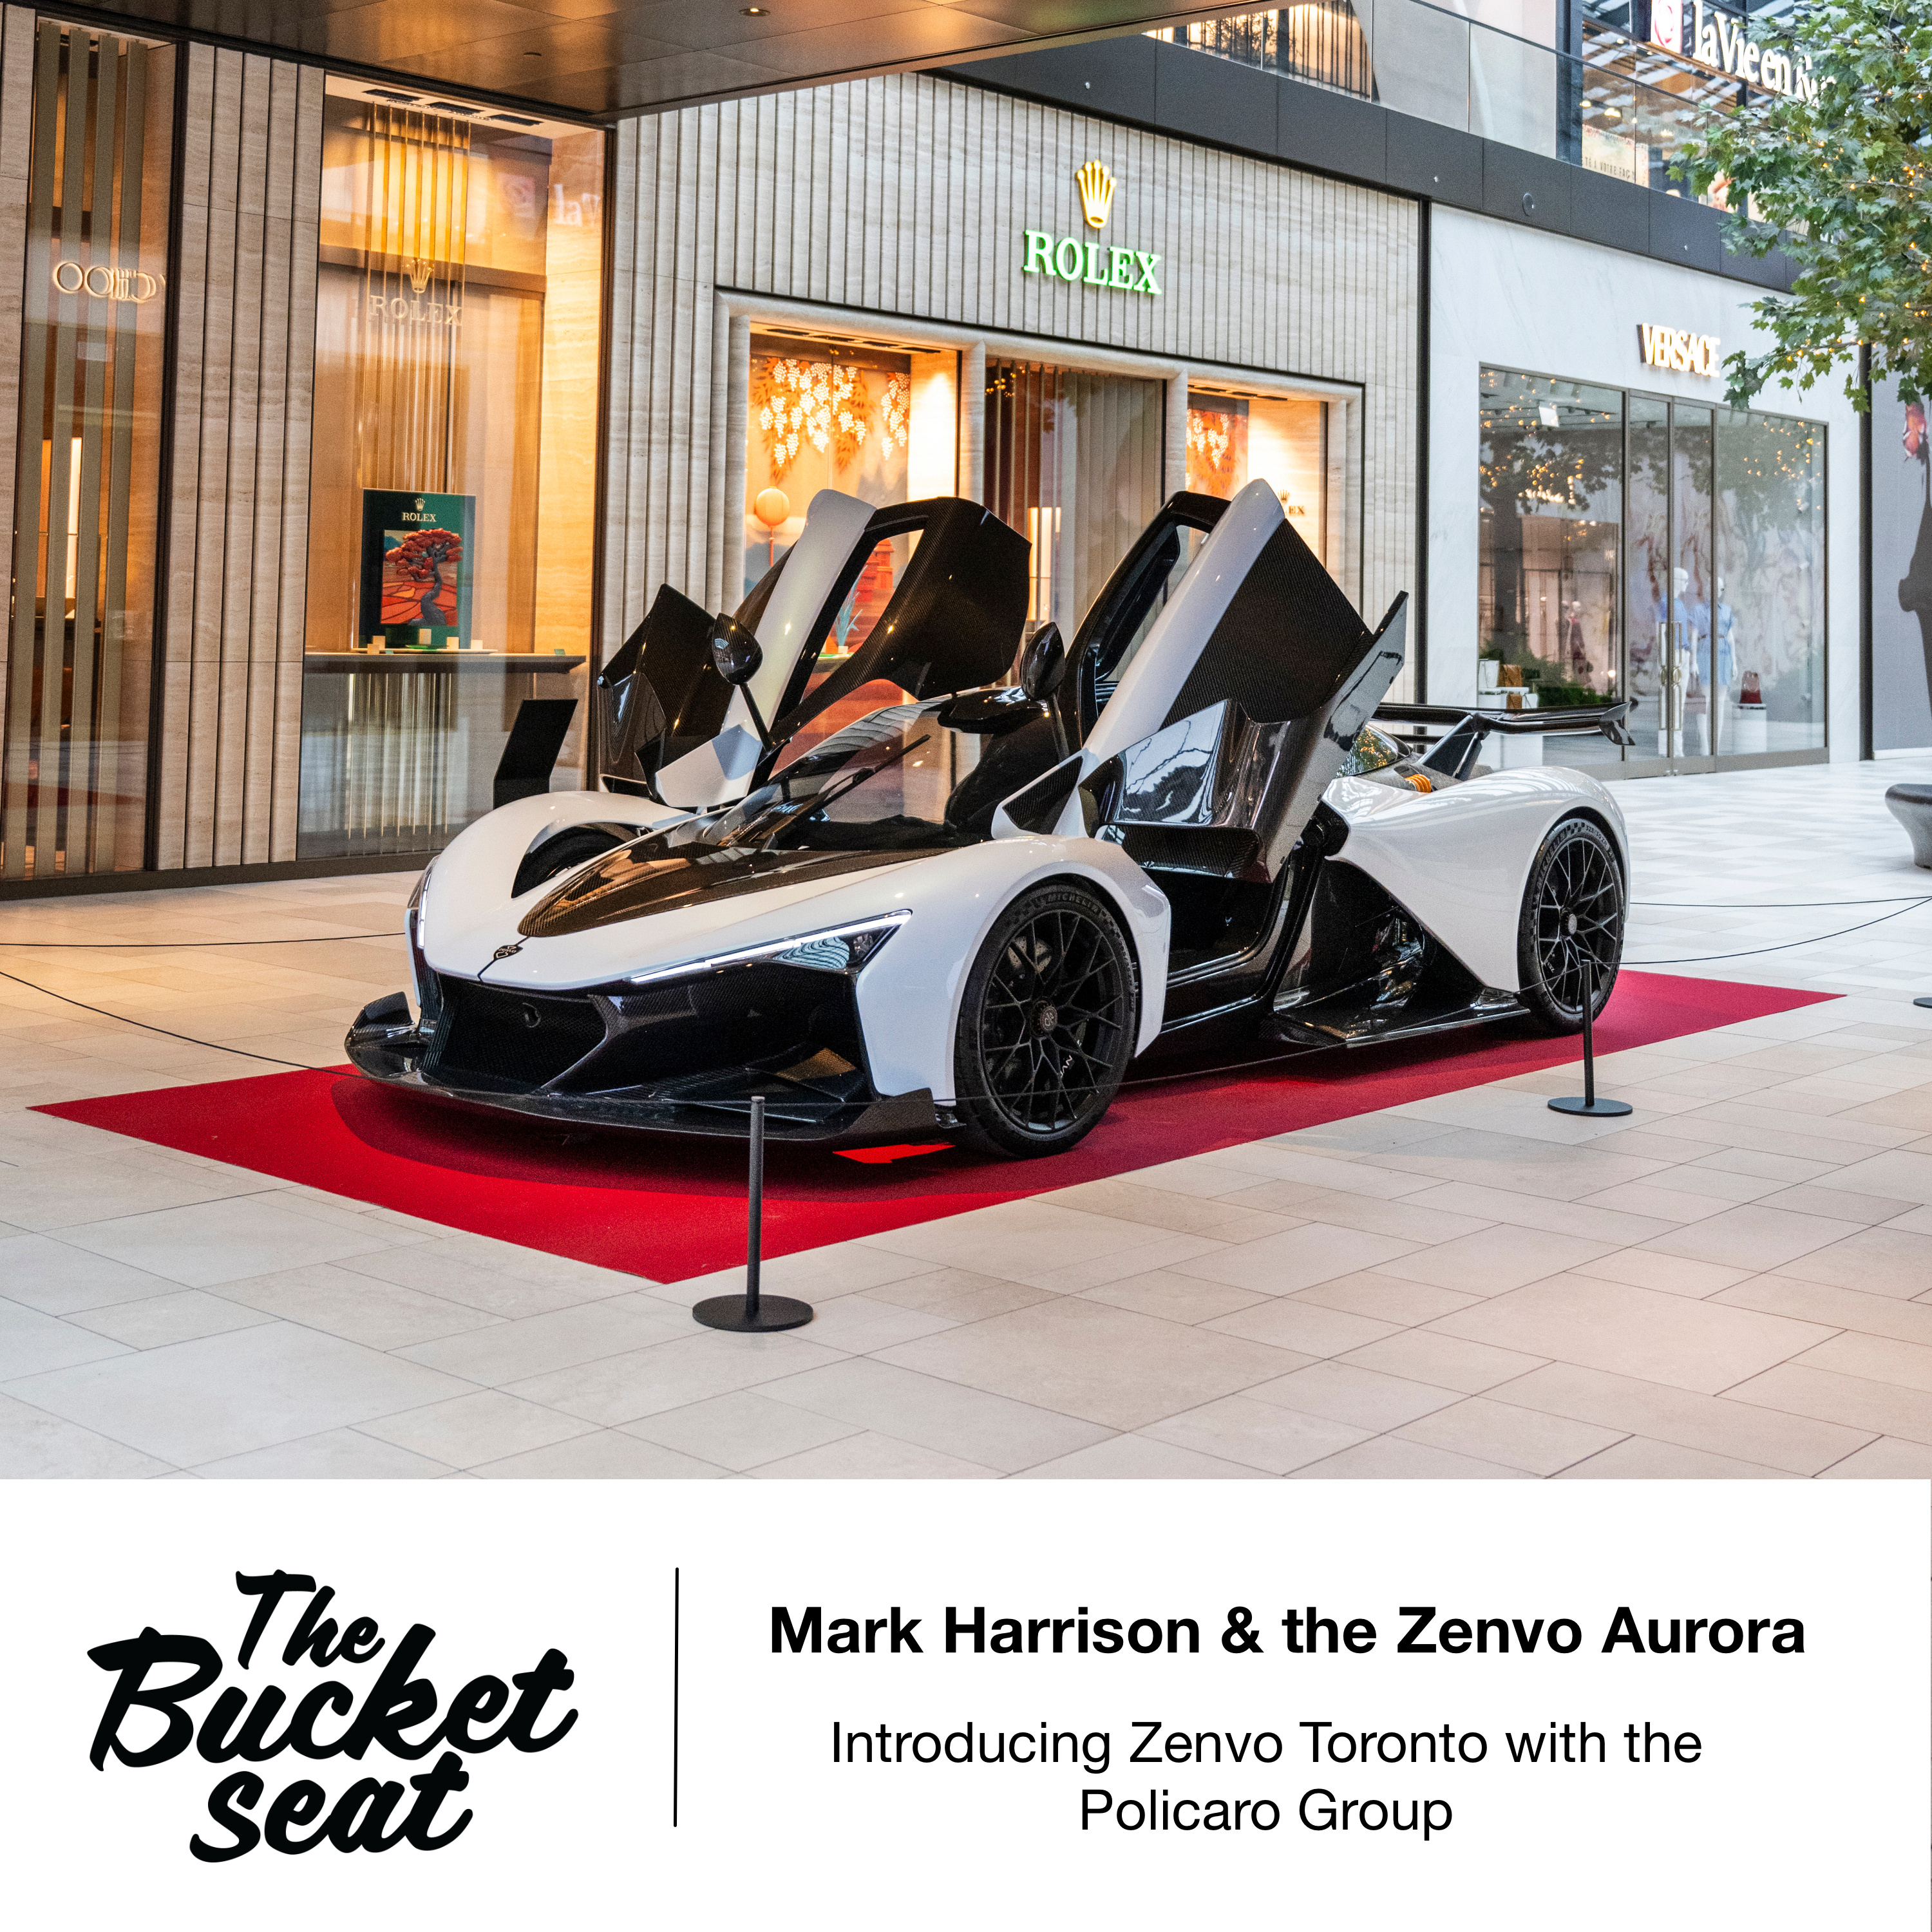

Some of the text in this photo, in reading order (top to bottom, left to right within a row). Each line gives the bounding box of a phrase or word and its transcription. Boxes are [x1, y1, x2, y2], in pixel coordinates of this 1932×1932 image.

[1023, 229, 1162, 295] ROLEX
[370, 295, 462, 326] ROLEX
[1637, 322, 1721, 378] VERSACE
[402, 512, 437, 522] ROLEX
[1048, 893, 1099, 913] MICHELIN
